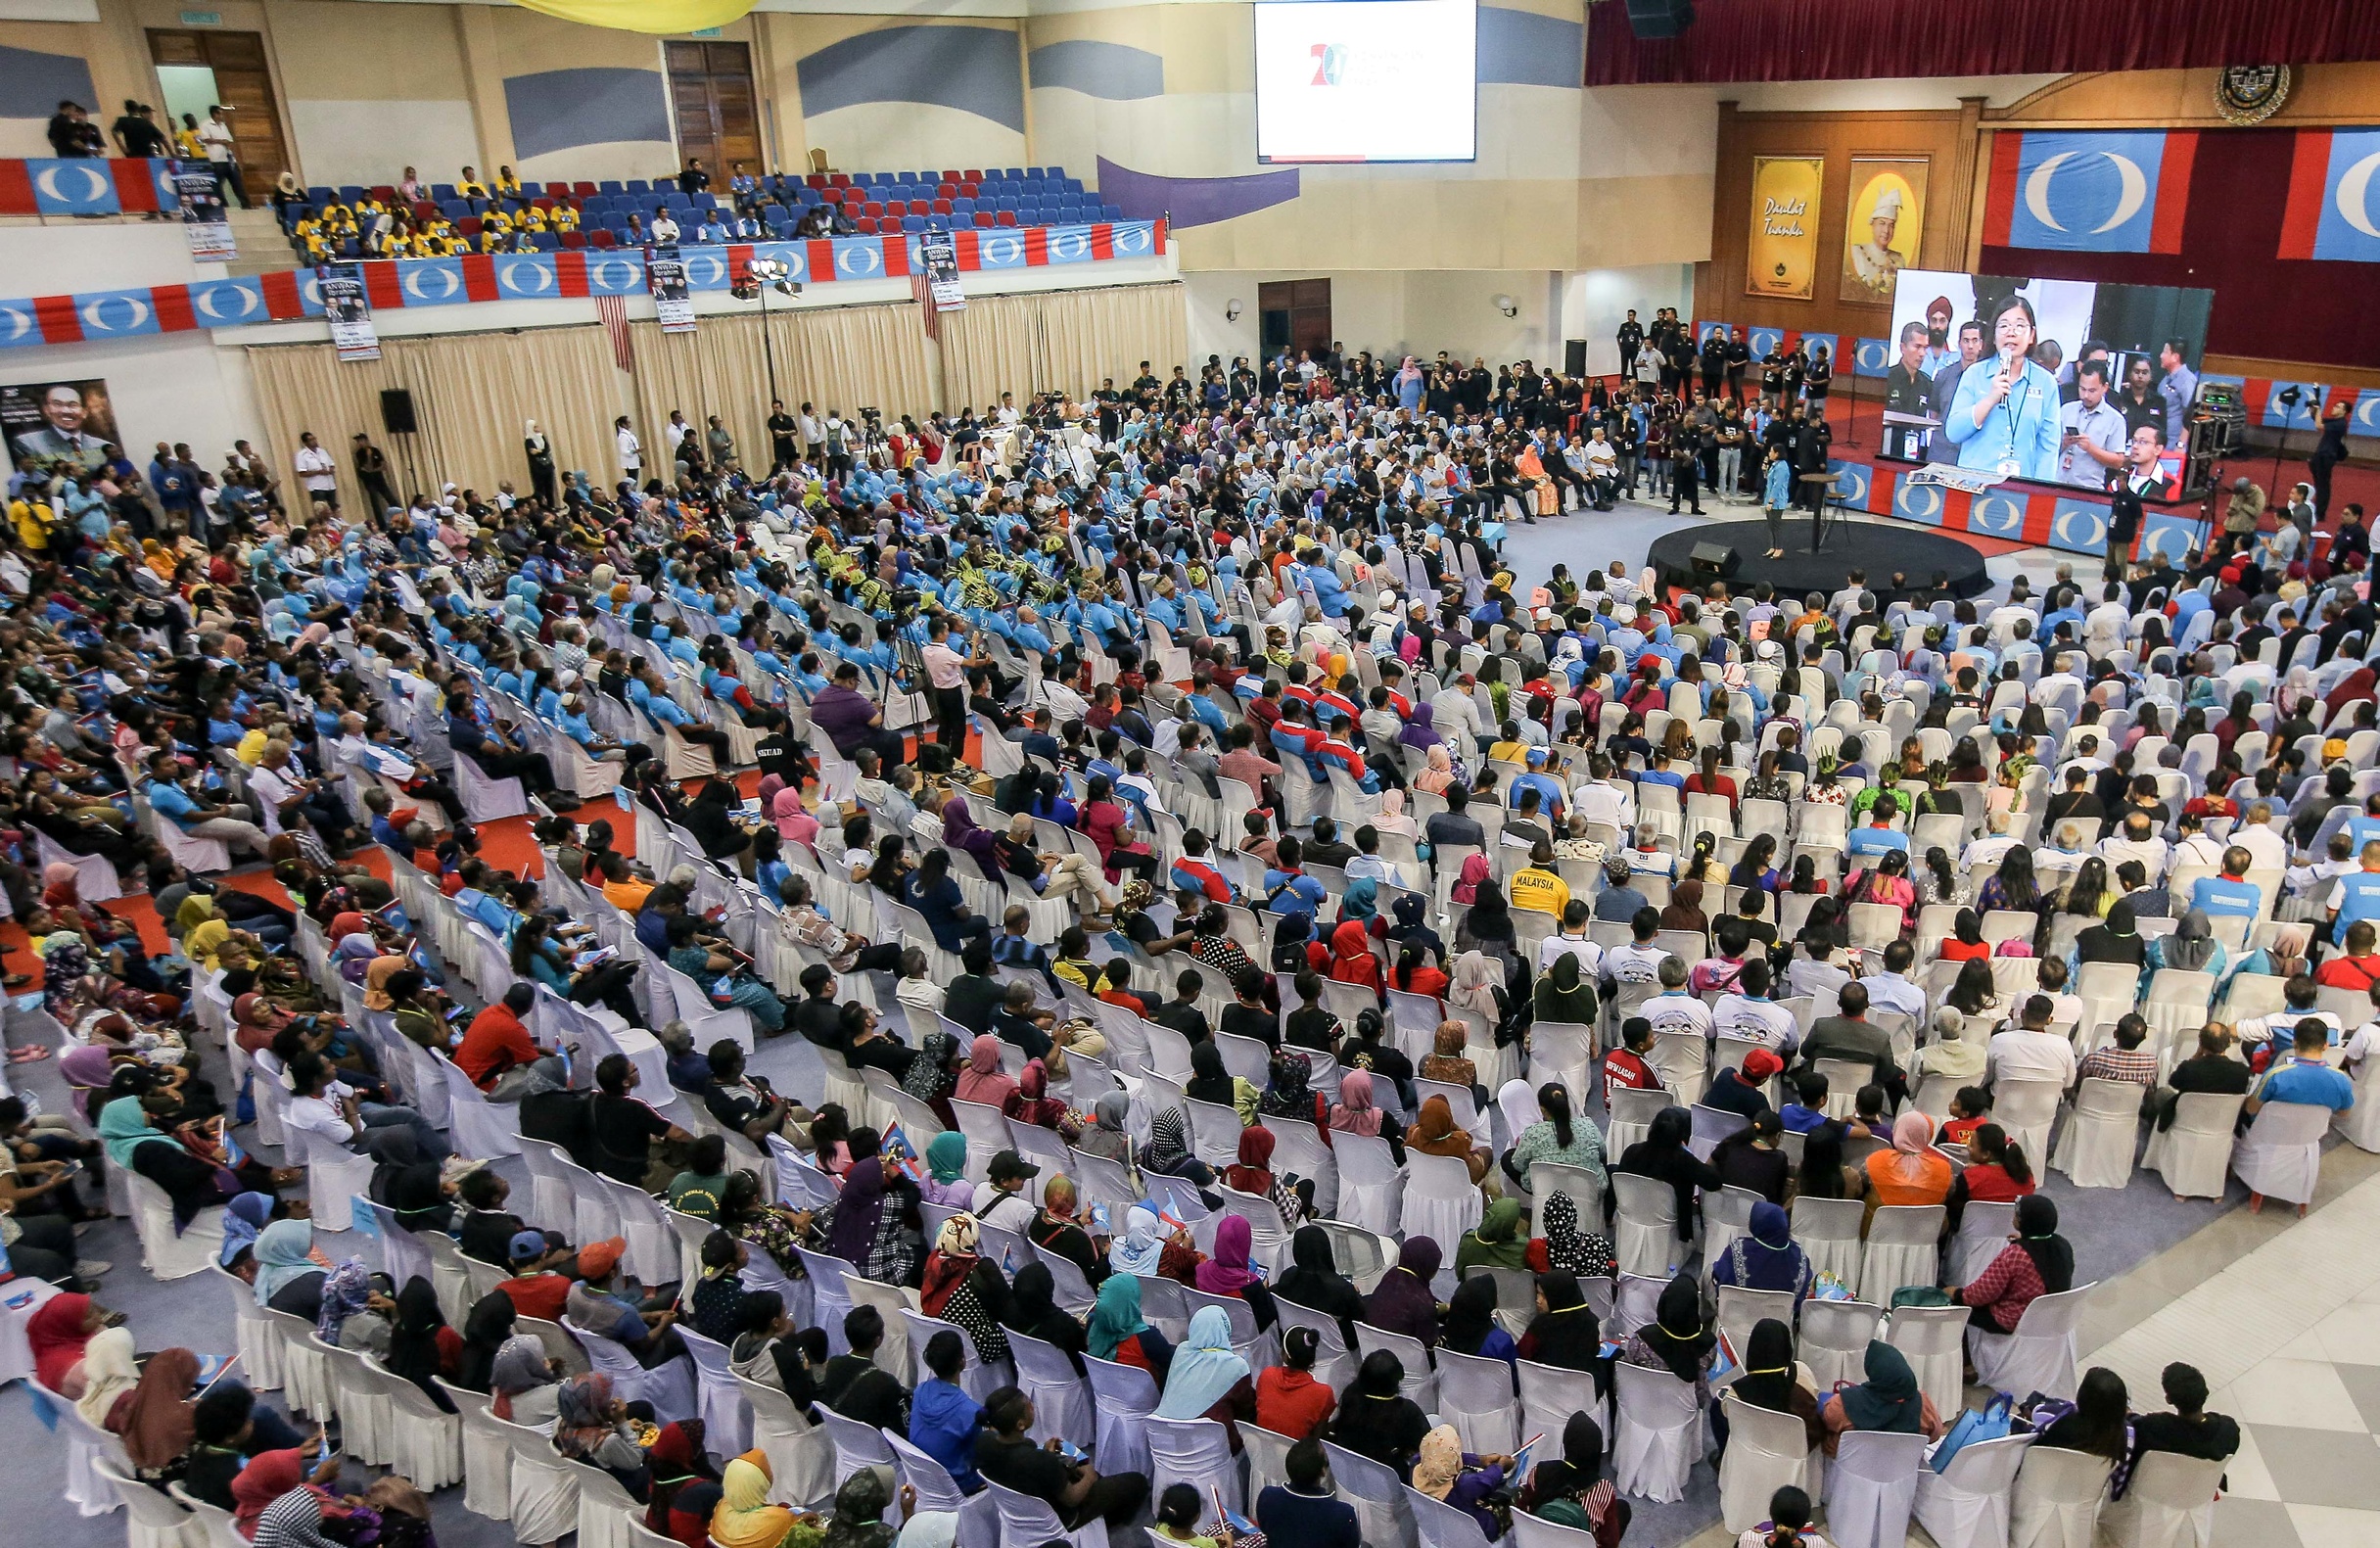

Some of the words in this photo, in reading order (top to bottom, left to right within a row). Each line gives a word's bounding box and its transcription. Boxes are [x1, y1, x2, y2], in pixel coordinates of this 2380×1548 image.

[1765, 197, 1806, 215] Daulat
[1764, 217, 1804, 237] Tuanku
[1517, 876, 1554, 891] MALAYSIA
